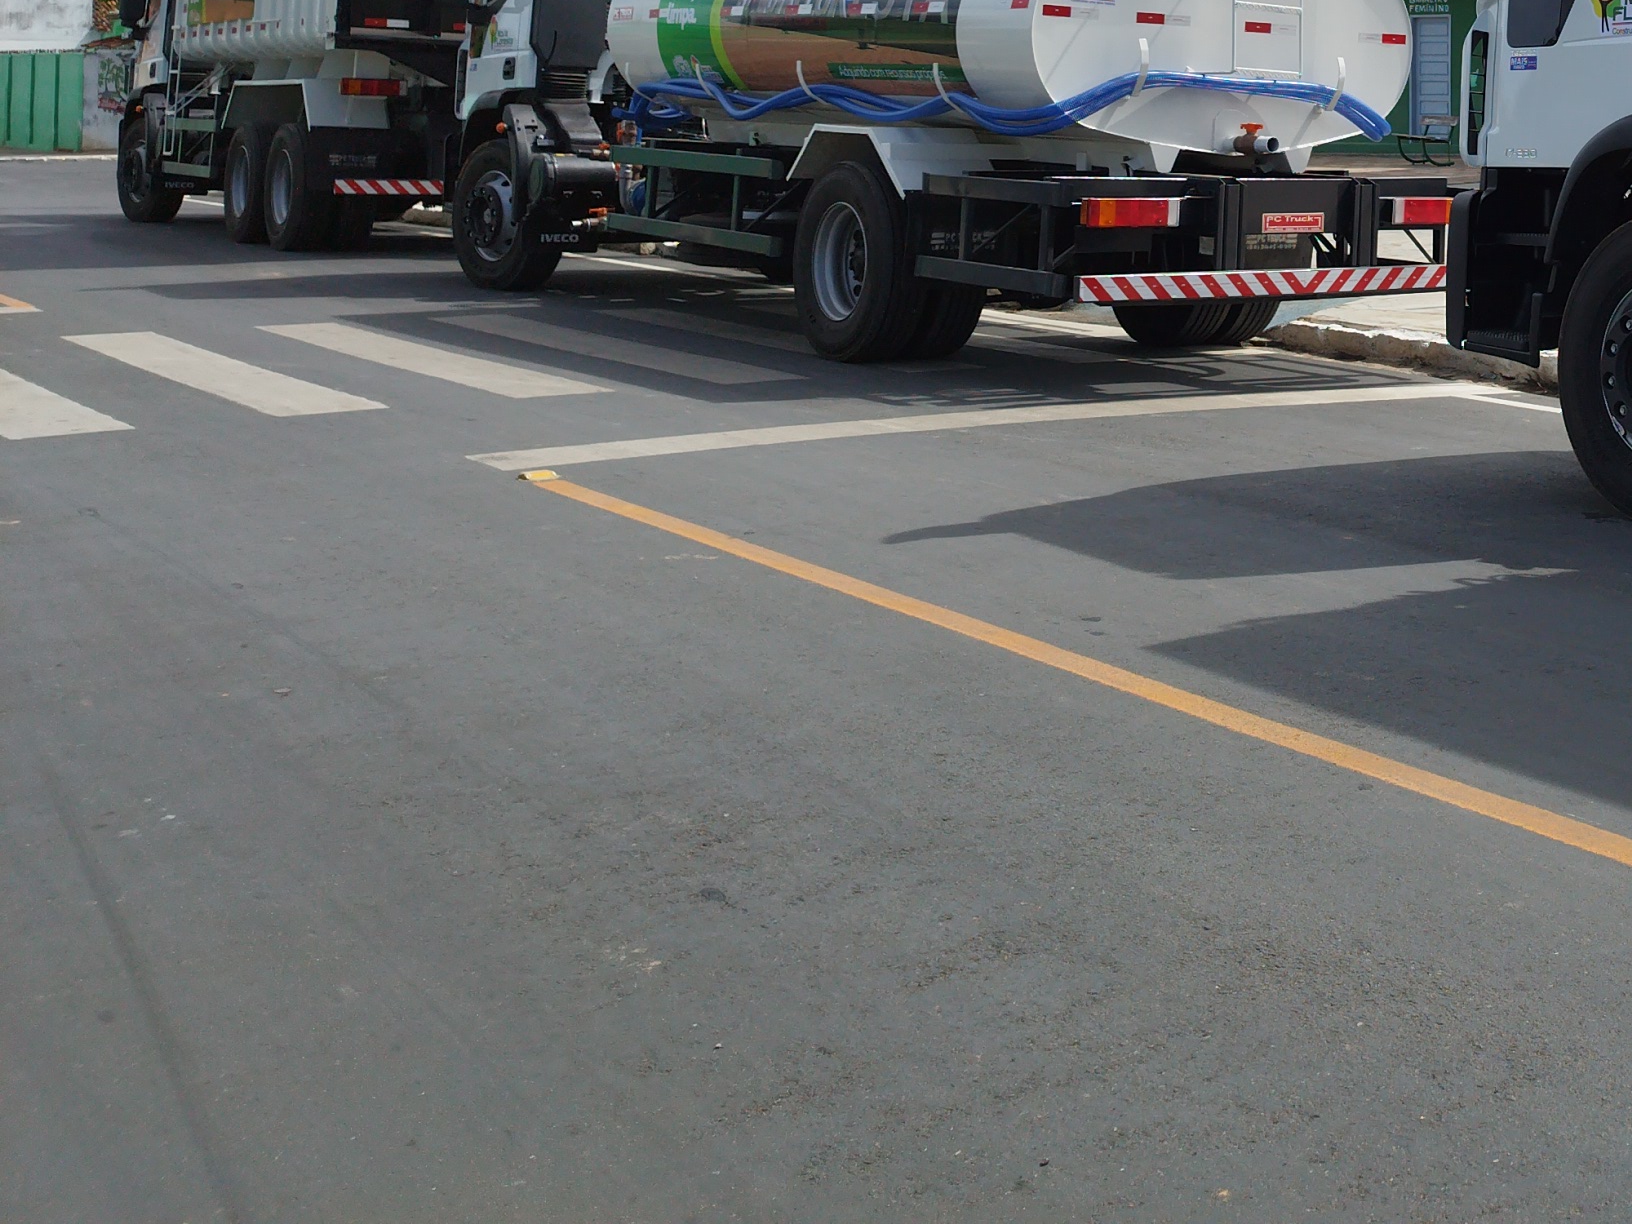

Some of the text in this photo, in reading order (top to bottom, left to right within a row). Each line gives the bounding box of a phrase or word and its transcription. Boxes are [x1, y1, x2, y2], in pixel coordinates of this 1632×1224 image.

[1408, 4, 1450, 13] FEMININO
[1267, 215, 1314, 223] PC Truck
[540, 233, 580, 243] IVECO
